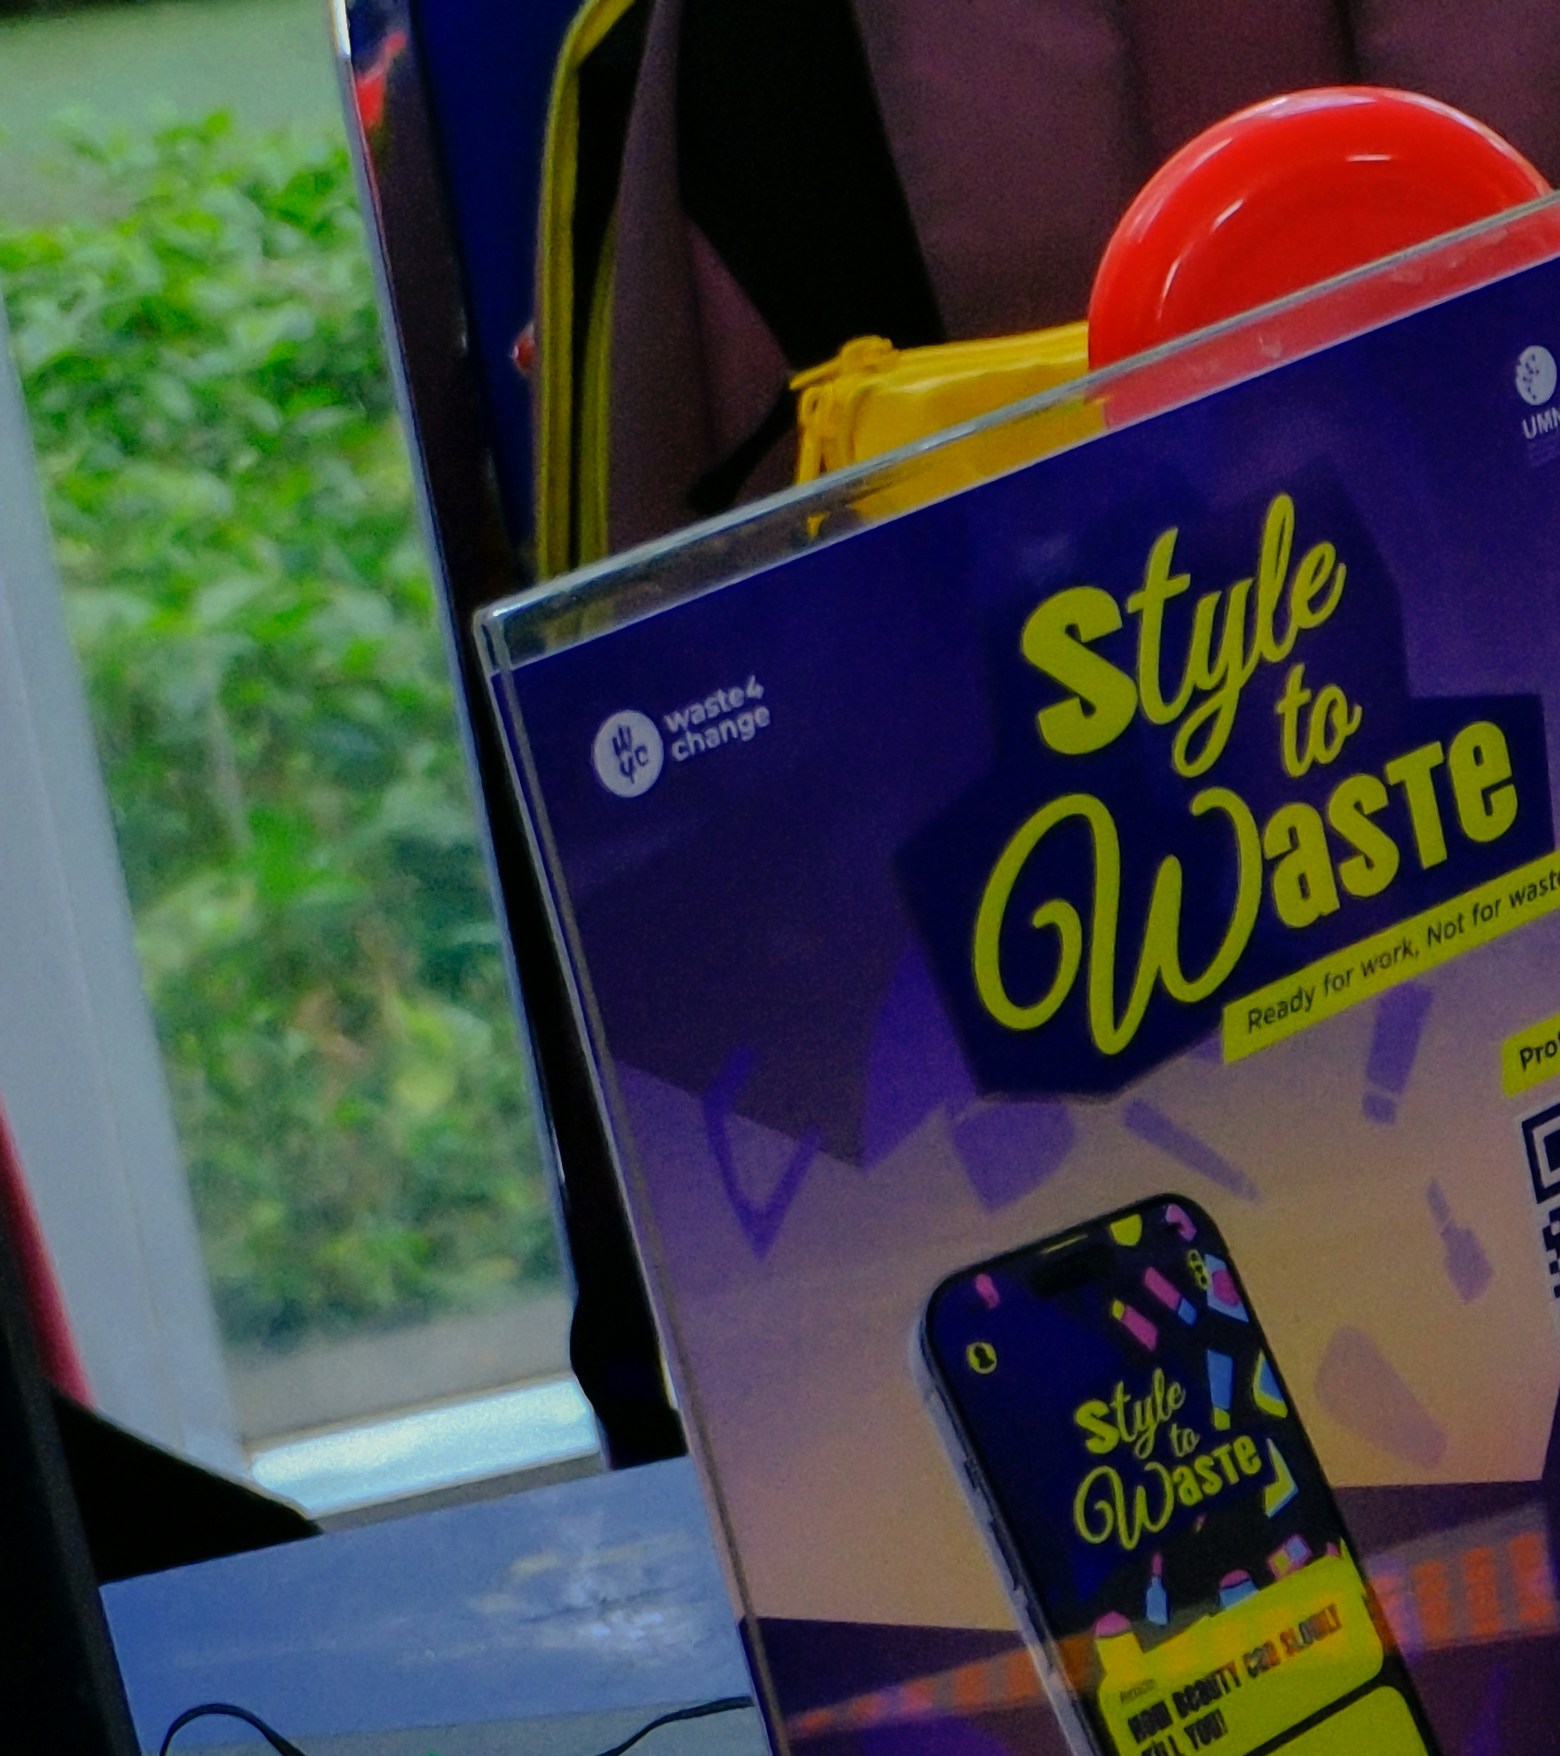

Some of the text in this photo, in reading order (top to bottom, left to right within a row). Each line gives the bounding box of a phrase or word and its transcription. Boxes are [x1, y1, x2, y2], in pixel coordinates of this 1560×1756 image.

[1020, 493, 1346, 778] Style
[671, 706, 770, 762] change
[1275, 662, 1362, 778] to
[1247, 985, 1317, 1034] Ready
[1322, 967, 1355, 998] for
[1361, 941, 1420, 984] work,
[1425, 917, 1465, 951] Not
[1472, 898, 1503, 925] for
[1073, 1367, 1187, 1459] Style
[1168, 1420, 1202, 1458] to
